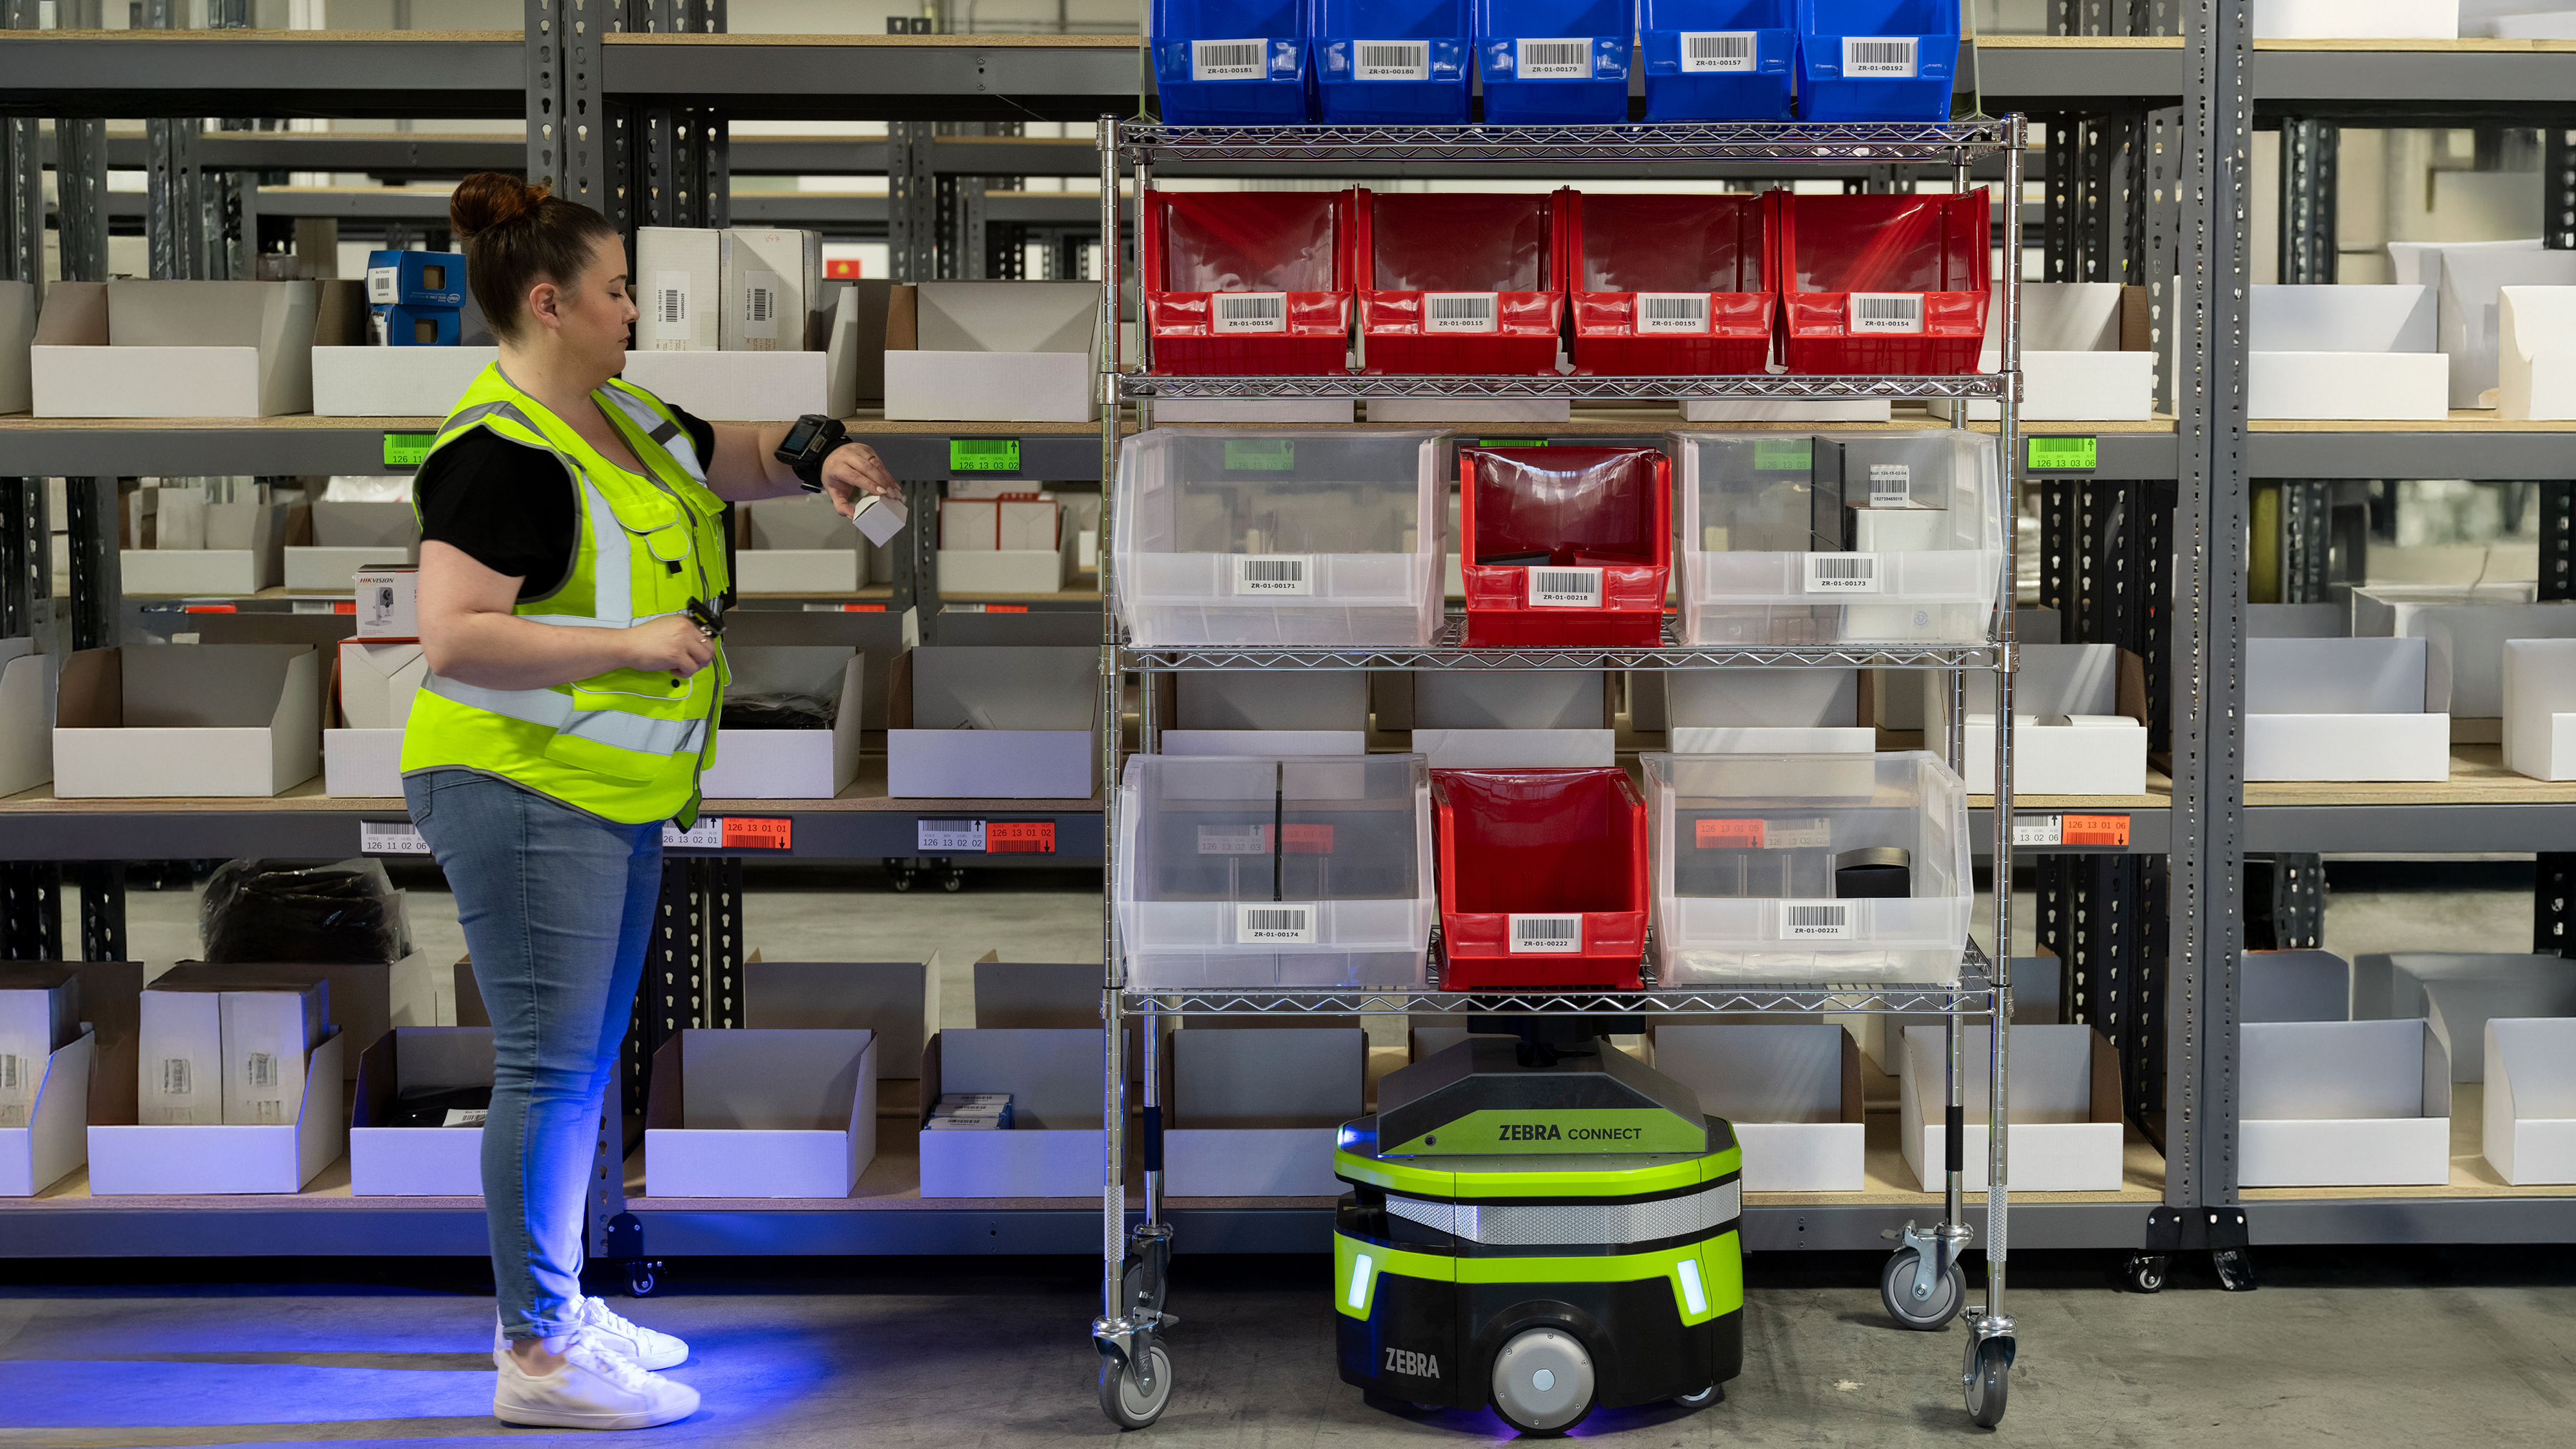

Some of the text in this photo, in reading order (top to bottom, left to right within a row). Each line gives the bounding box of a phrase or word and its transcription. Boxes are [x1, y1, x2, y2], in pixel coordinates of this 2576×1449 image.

[1498, 1124, 1642, 1141] ZEBRA CONNECT
[1385, 1347, 1440, 1379] ZEBRA
